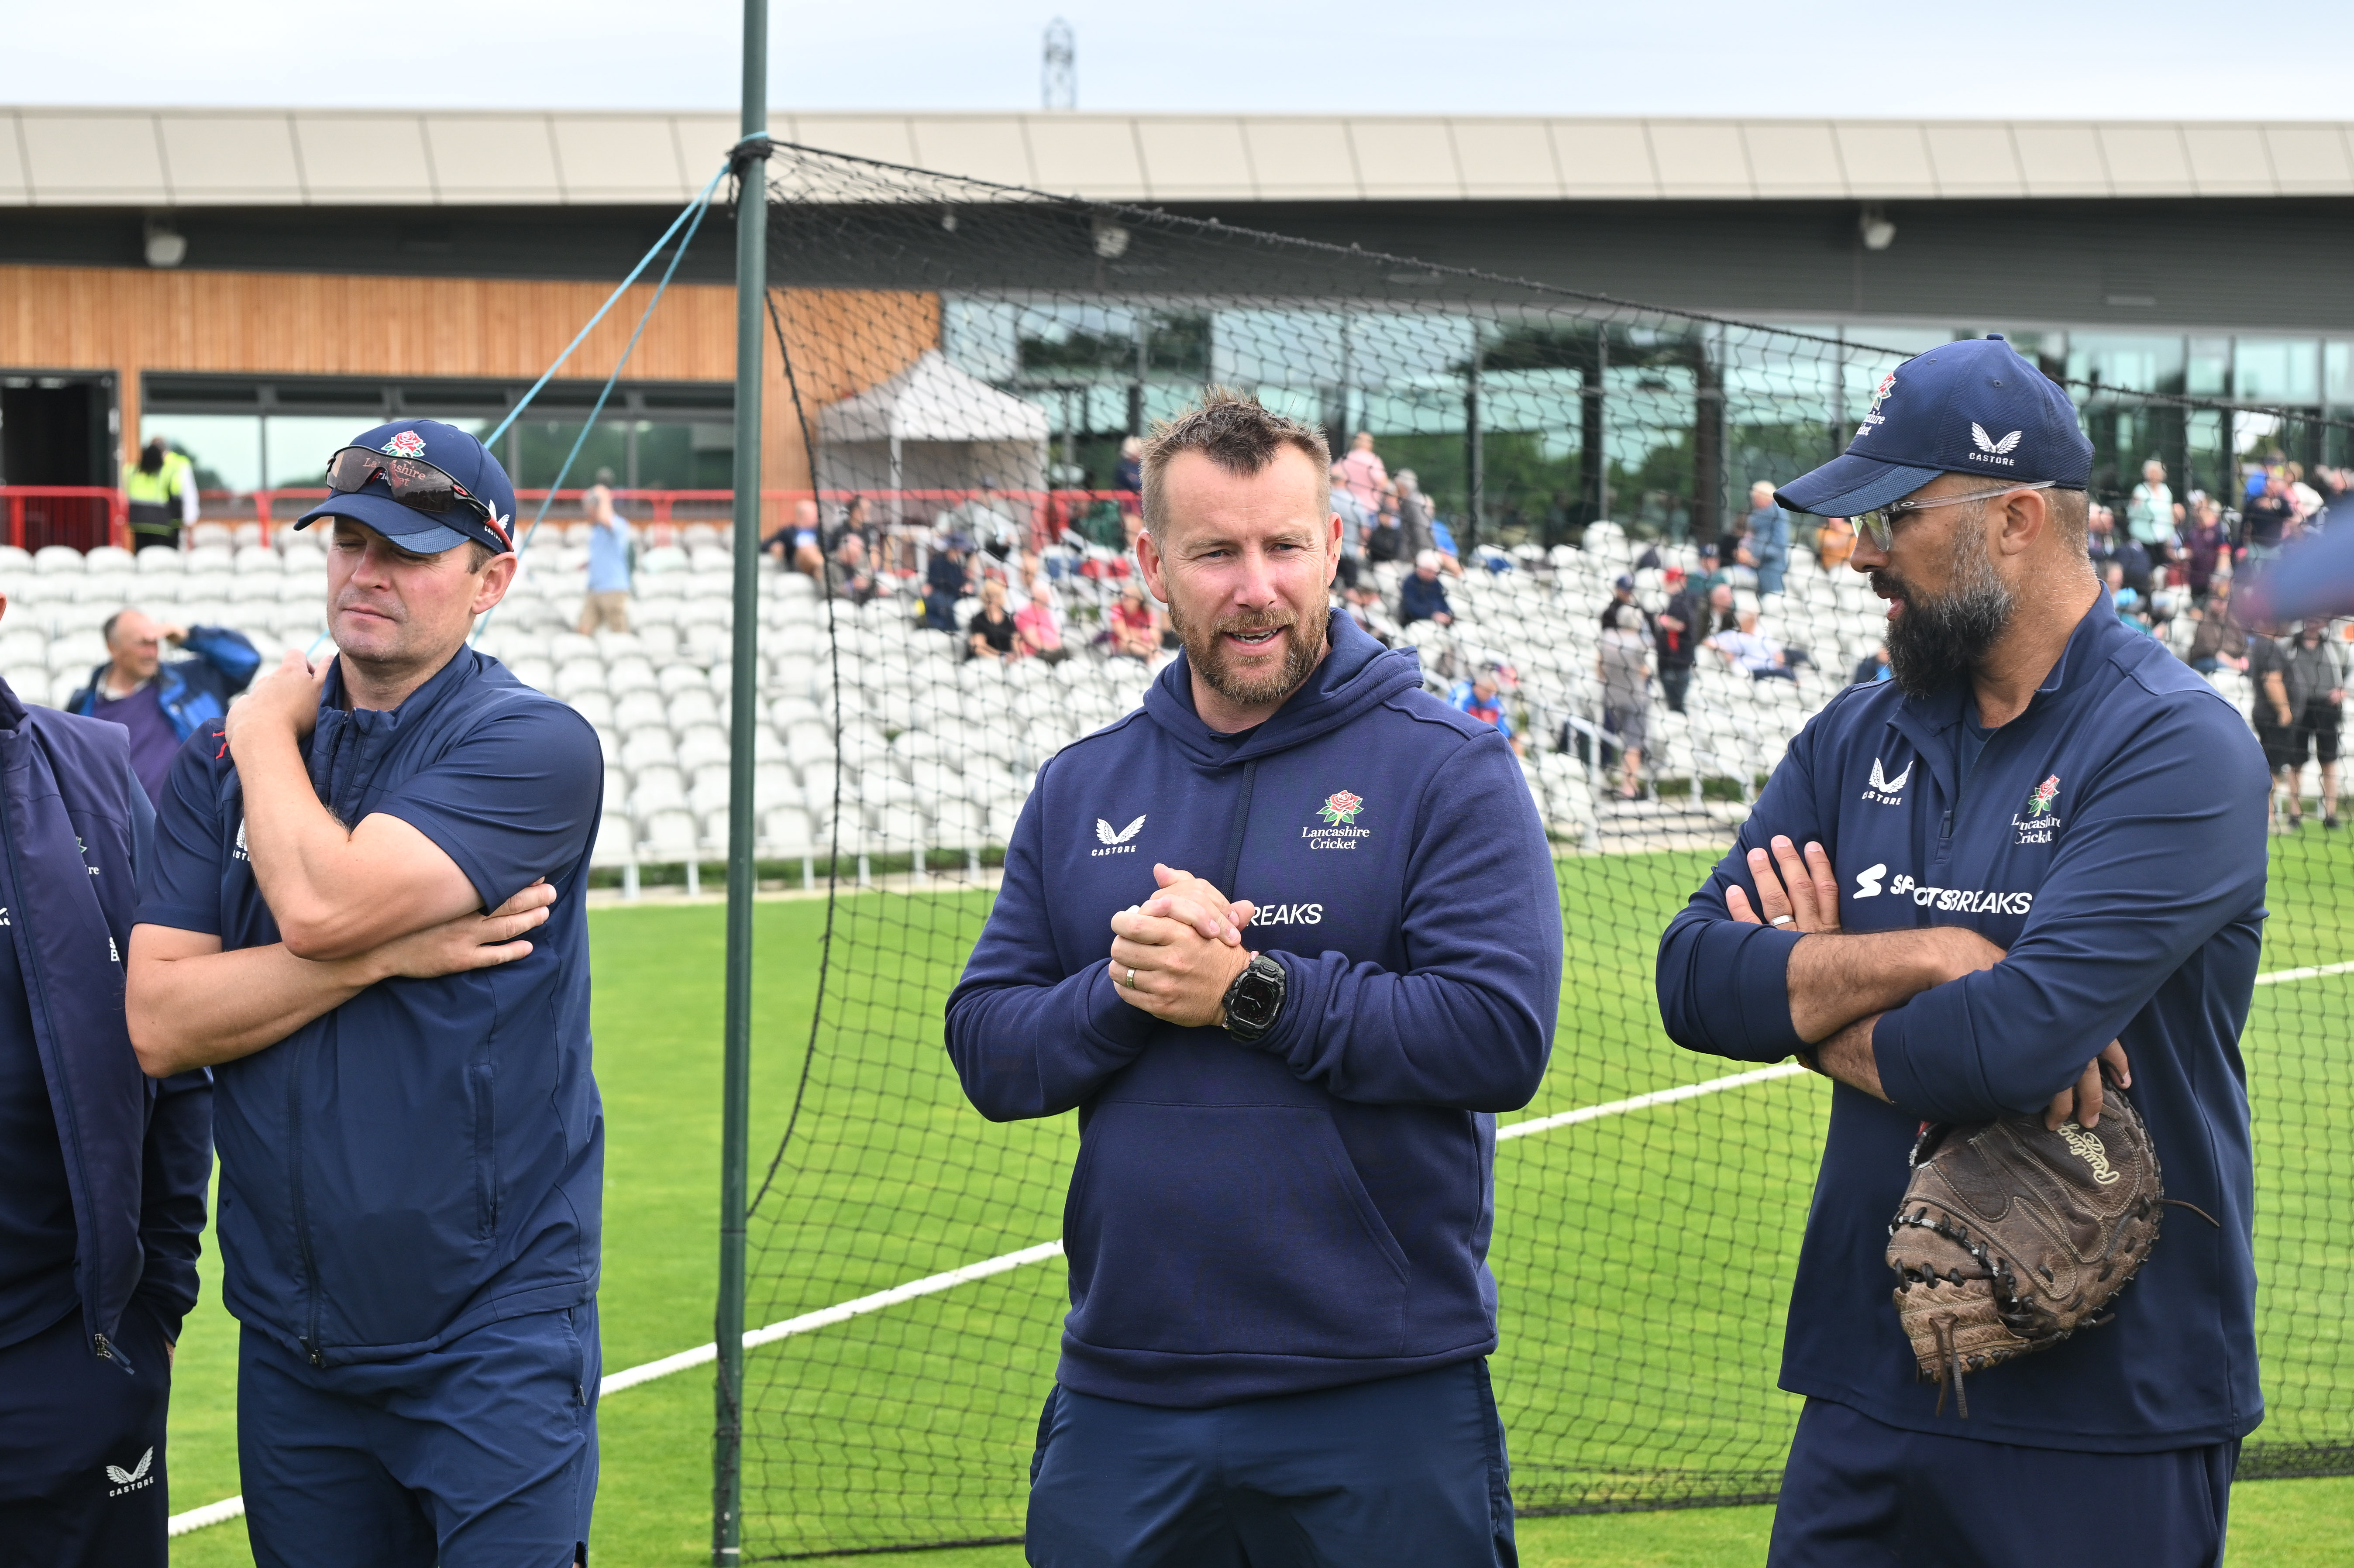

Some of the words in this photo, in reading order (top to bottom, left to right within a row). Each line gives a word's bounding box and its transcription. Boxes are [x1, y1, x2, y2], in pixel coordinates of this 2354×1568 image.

[1969, 452, 2015, 466] CASTORE
[1301, 826, 1370, 838] Lancashire
[2015, 830, 2052, 844] Crickt
[1091, 845, 1136, 856] CASTORE
[1310, 838, 1357, 849] Cricket
[1890, 874, 2033, 915] SPOTSBREAKS
[1246, 904, 1323, 926] REAKS
[2057, 1123, 2120, 1185] Rawling
[109, 1476, 154, 1497] CASTORE
